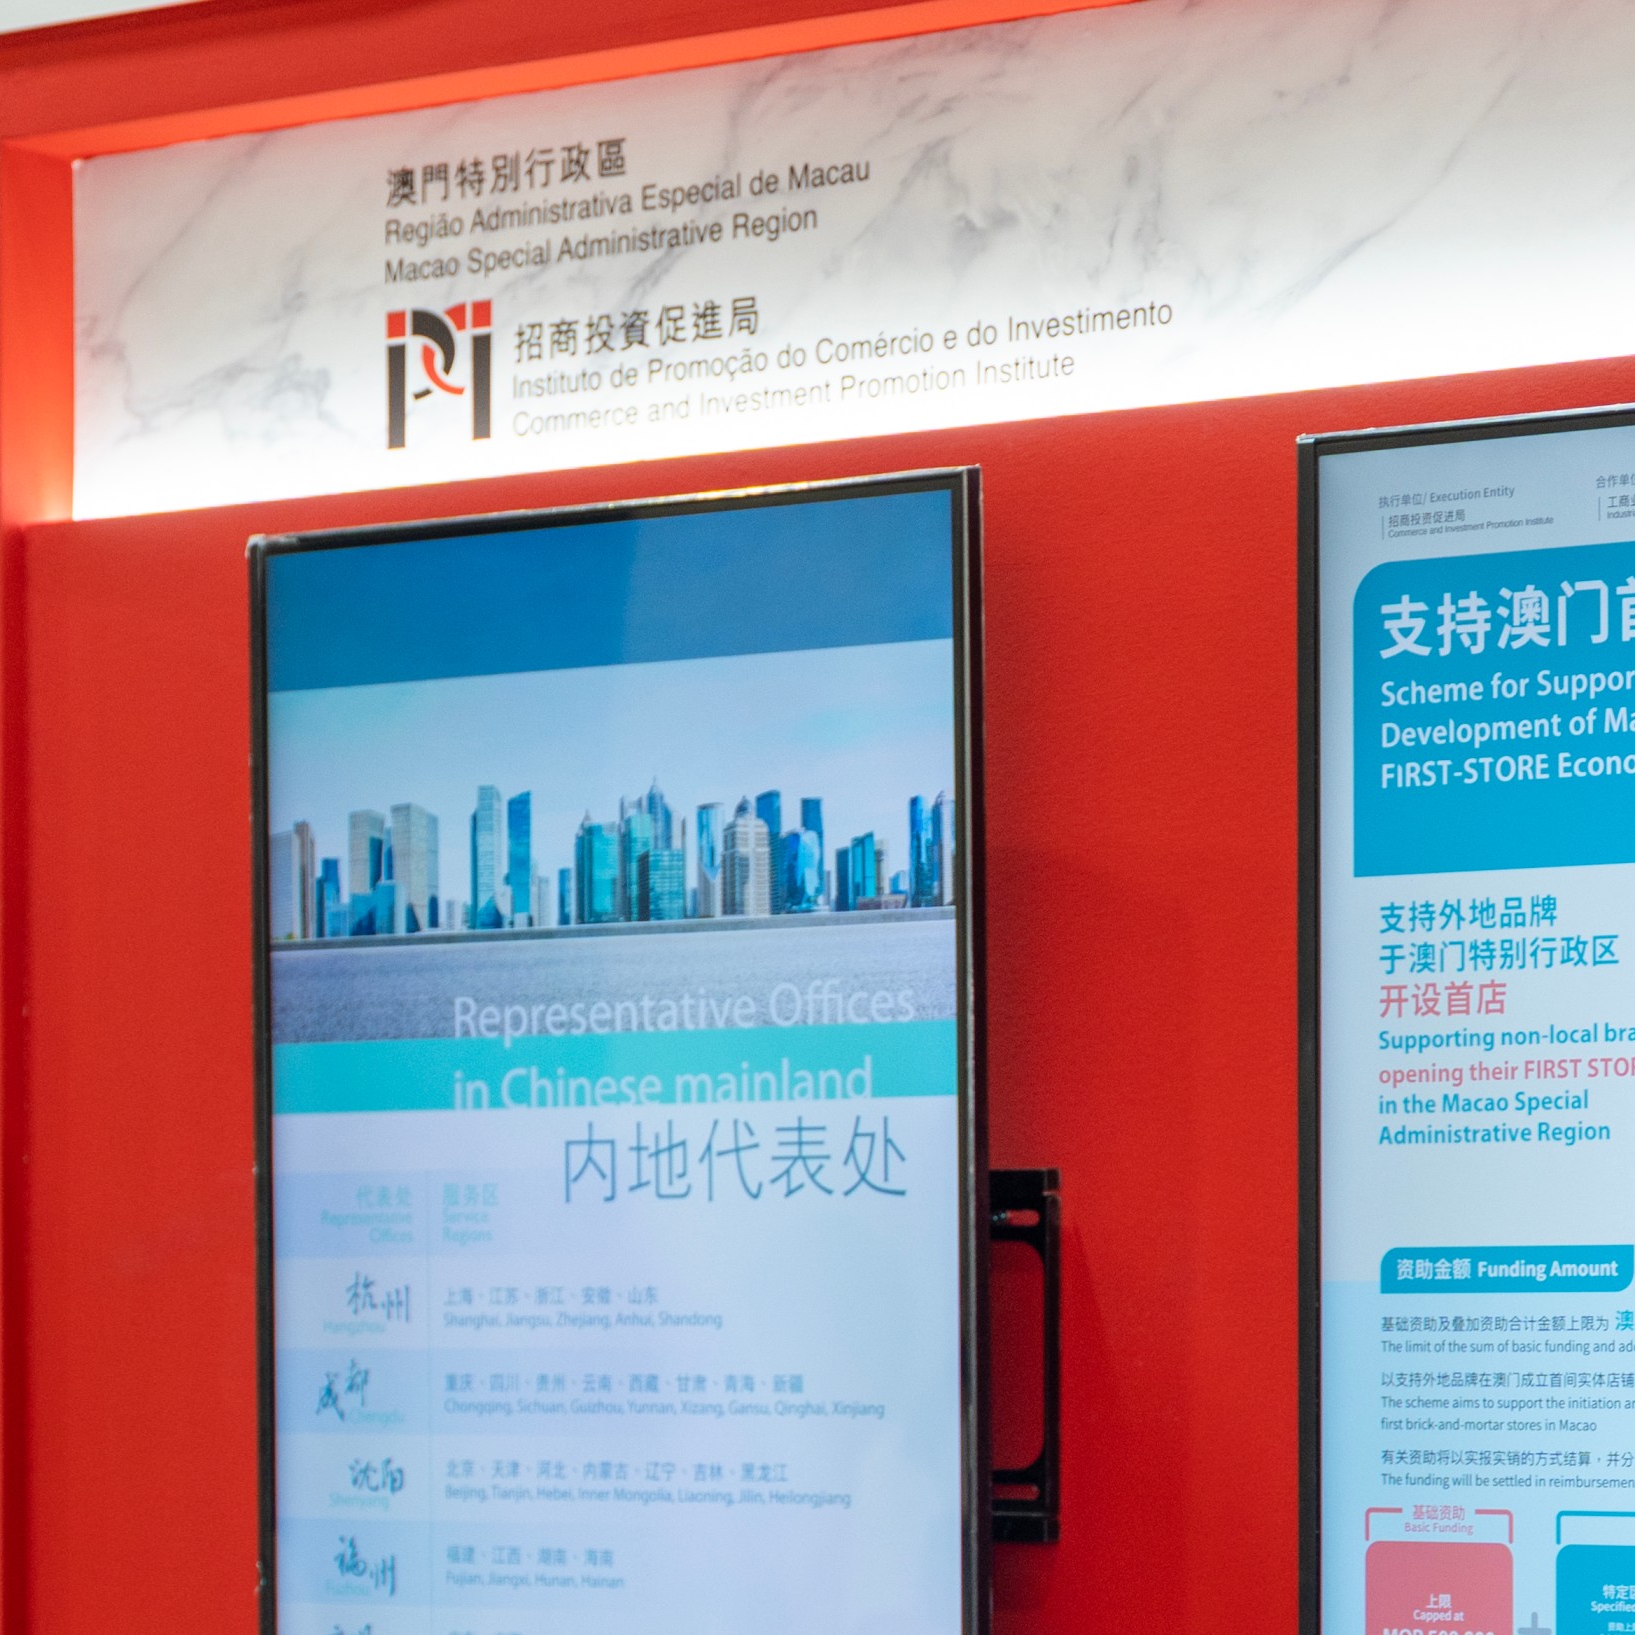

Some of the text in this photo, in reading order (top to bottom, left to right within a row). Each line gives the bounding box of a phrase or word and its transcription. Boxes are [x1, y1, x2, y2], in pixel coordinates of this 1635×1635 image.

[387, 137, 626, 207] 澳門特別行政區
[385, 161, 870, 246] Região Administrativa Especial de Macau
[385, 208, 817, 283] Macao Special Administrative Region
[513, 301, 1173, 397] Instituto de Promoção do Comércio e do Investimento
[516, 295, 758, 362] 招商投資促進局
[513, 352, 1075, 437] Commerce and Investment Promotion Institute
[1381, 680, 1484, 707] Scheme
[1491, 672, 1529, 699] for
[1382, 714, 1561, 748] Development
[1569, 707, 1597, 735] of
[1382, 754, 1550, 788] FIRST-STORE
[1379, 894, 1557, 934] 支持外地品牌
[1379, 934, 1619, 975] 于澳门特别行政区
[452, 981, 916, 1047] Representative Offices
[1379, 979, 1507, 1018] 开设首店
[453, 1056, 873, 1110] in Chinese mainland
[564, 1115, 907, 1205] 内地代表处
[1397, 1258, 1618, 1281] 资助金额 Funding Amount
